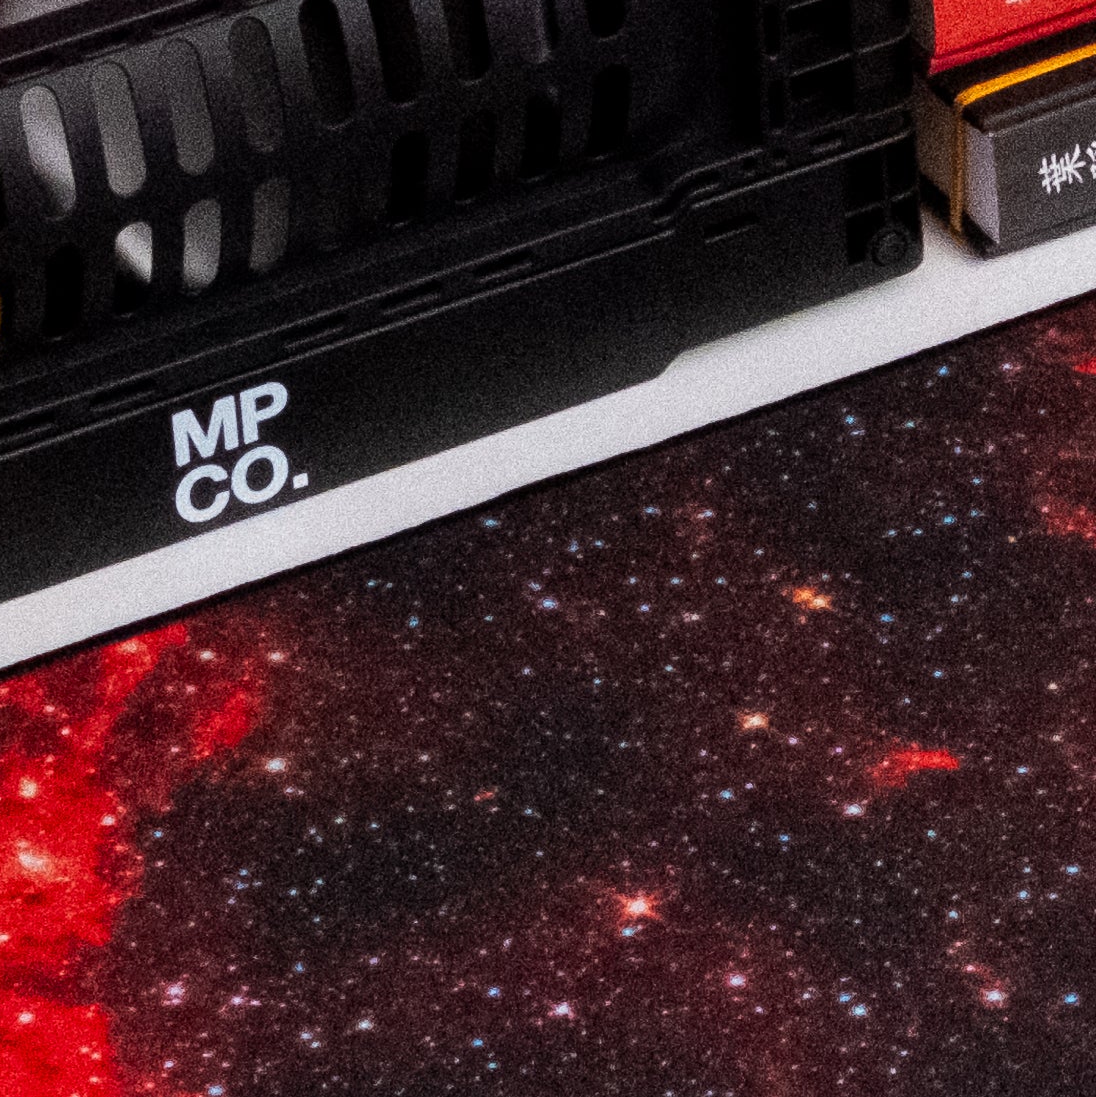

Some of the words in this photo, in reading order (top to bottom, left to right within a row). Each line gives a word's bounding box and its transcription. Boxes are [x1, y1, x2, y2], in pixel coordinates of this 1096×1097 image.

[1037, 142, 1096, 195] 葉
[172, 381, 288, 468] MP
[175, 445, 309, 523] CO.
